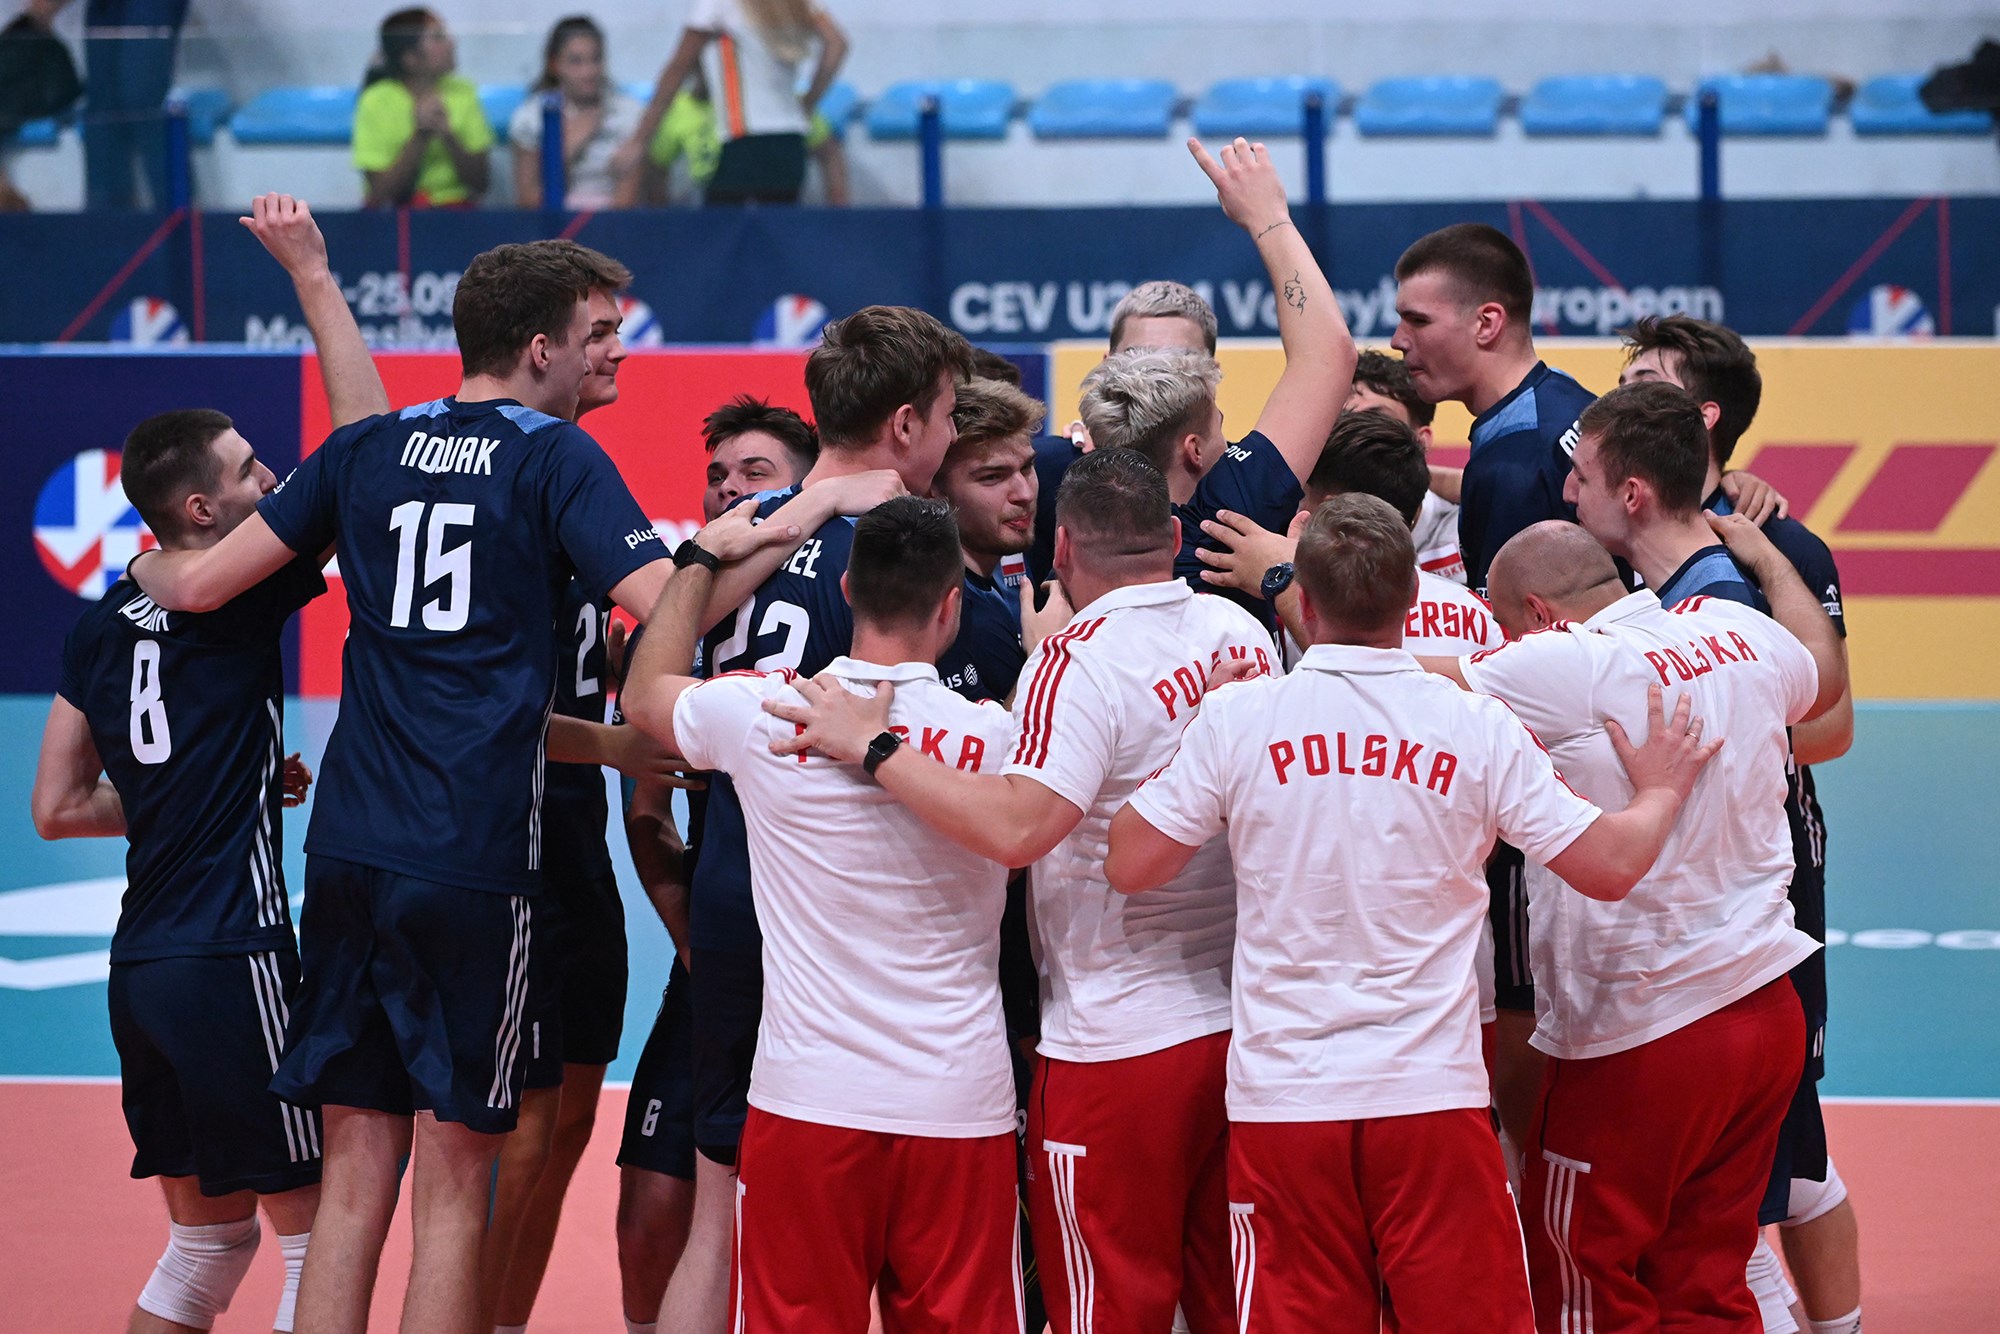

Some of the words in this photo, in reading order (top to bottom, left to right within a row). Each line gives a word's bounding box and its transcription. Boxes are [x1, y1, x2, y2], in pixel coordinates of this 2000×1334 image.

[949, 282, 1058, 332] CEV
[400, 431, 501, 476] NOWAK
[389, 500, 476, 632] 15
[1405, 601, 1488, 646] ERSKI
[130, 639, 172, 765] 8
[1268, 731, 1458, 797] POLSKA
[641, 1099, 663, 1138] 6
